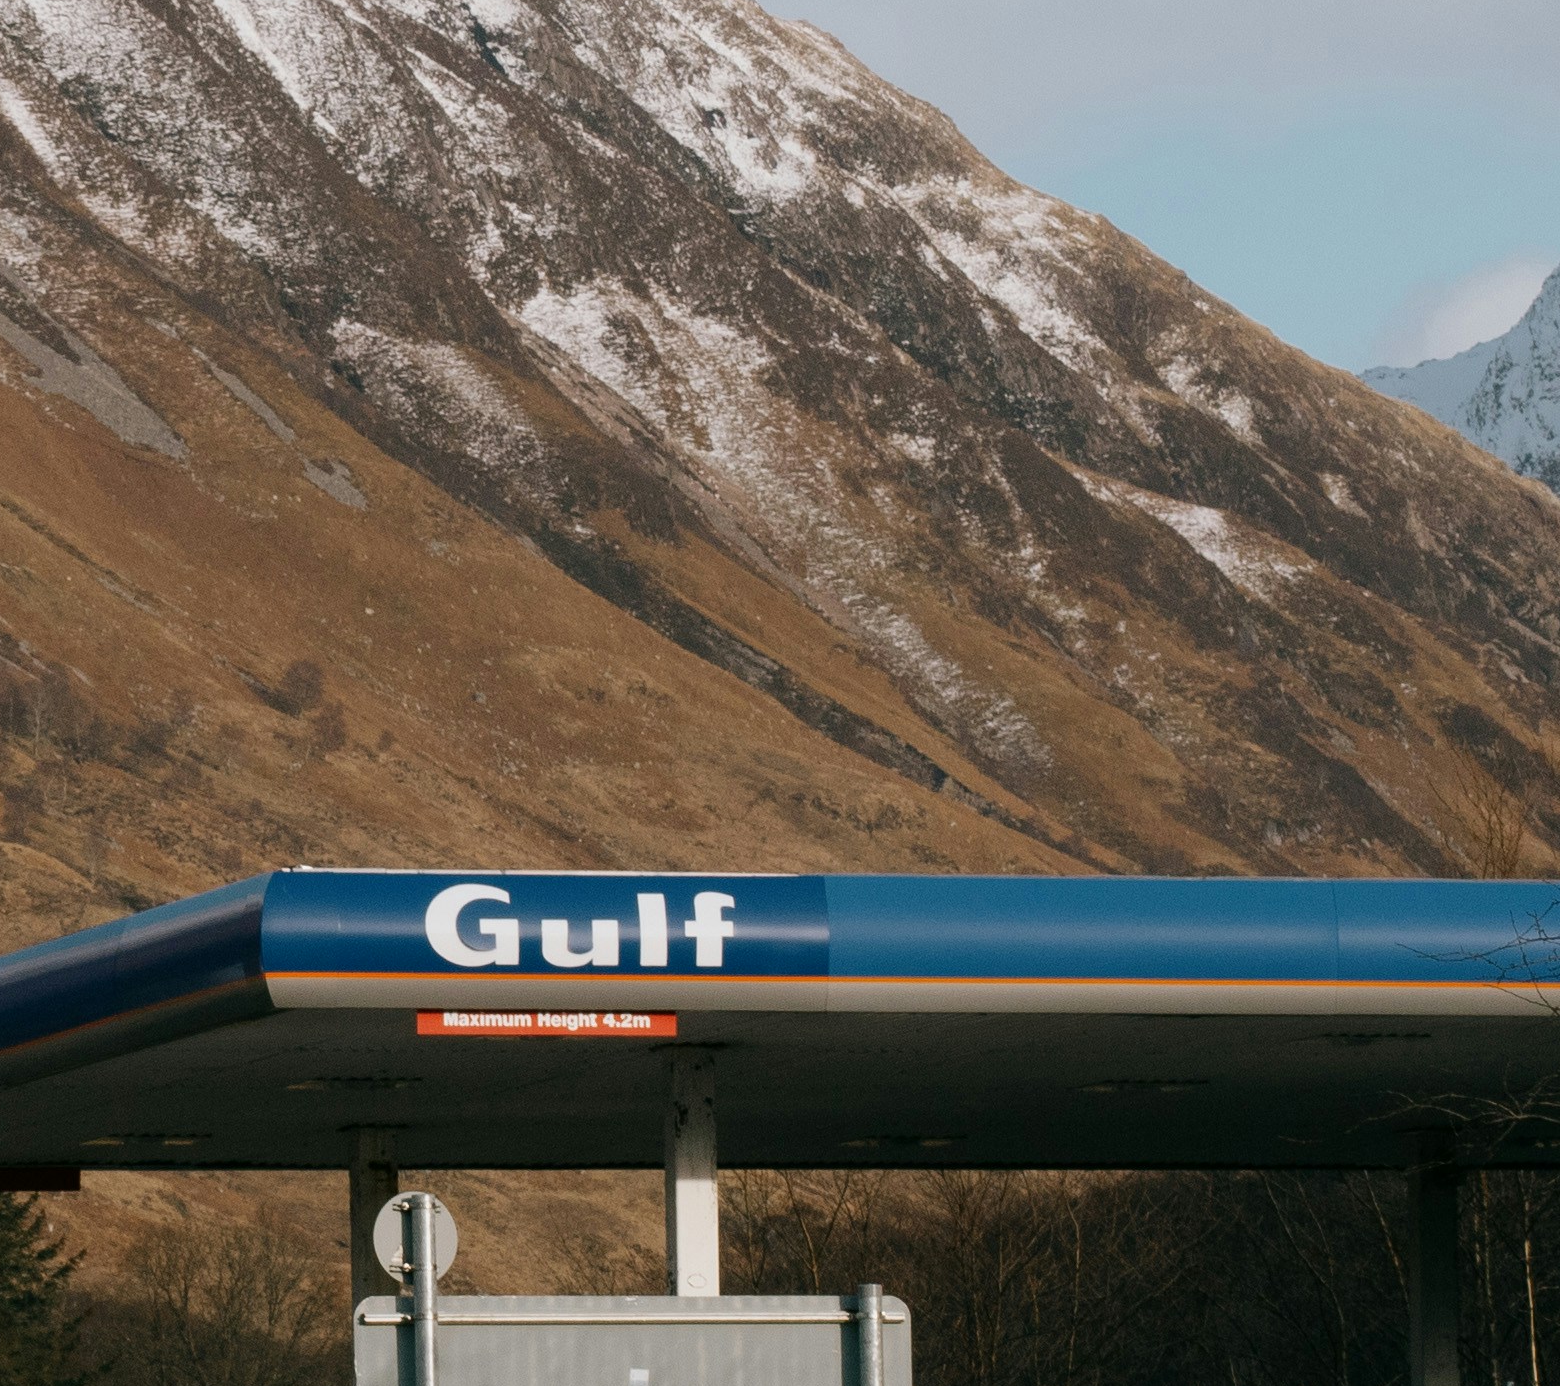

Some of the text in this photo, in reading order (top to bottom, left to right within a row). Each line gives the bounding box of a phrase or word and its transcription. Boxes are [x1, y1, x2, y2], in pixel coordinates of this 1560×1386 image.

[425, 883, 735, 967] Gulf
[442, 1012, 651, 1031] Maximum Height 4.2m
